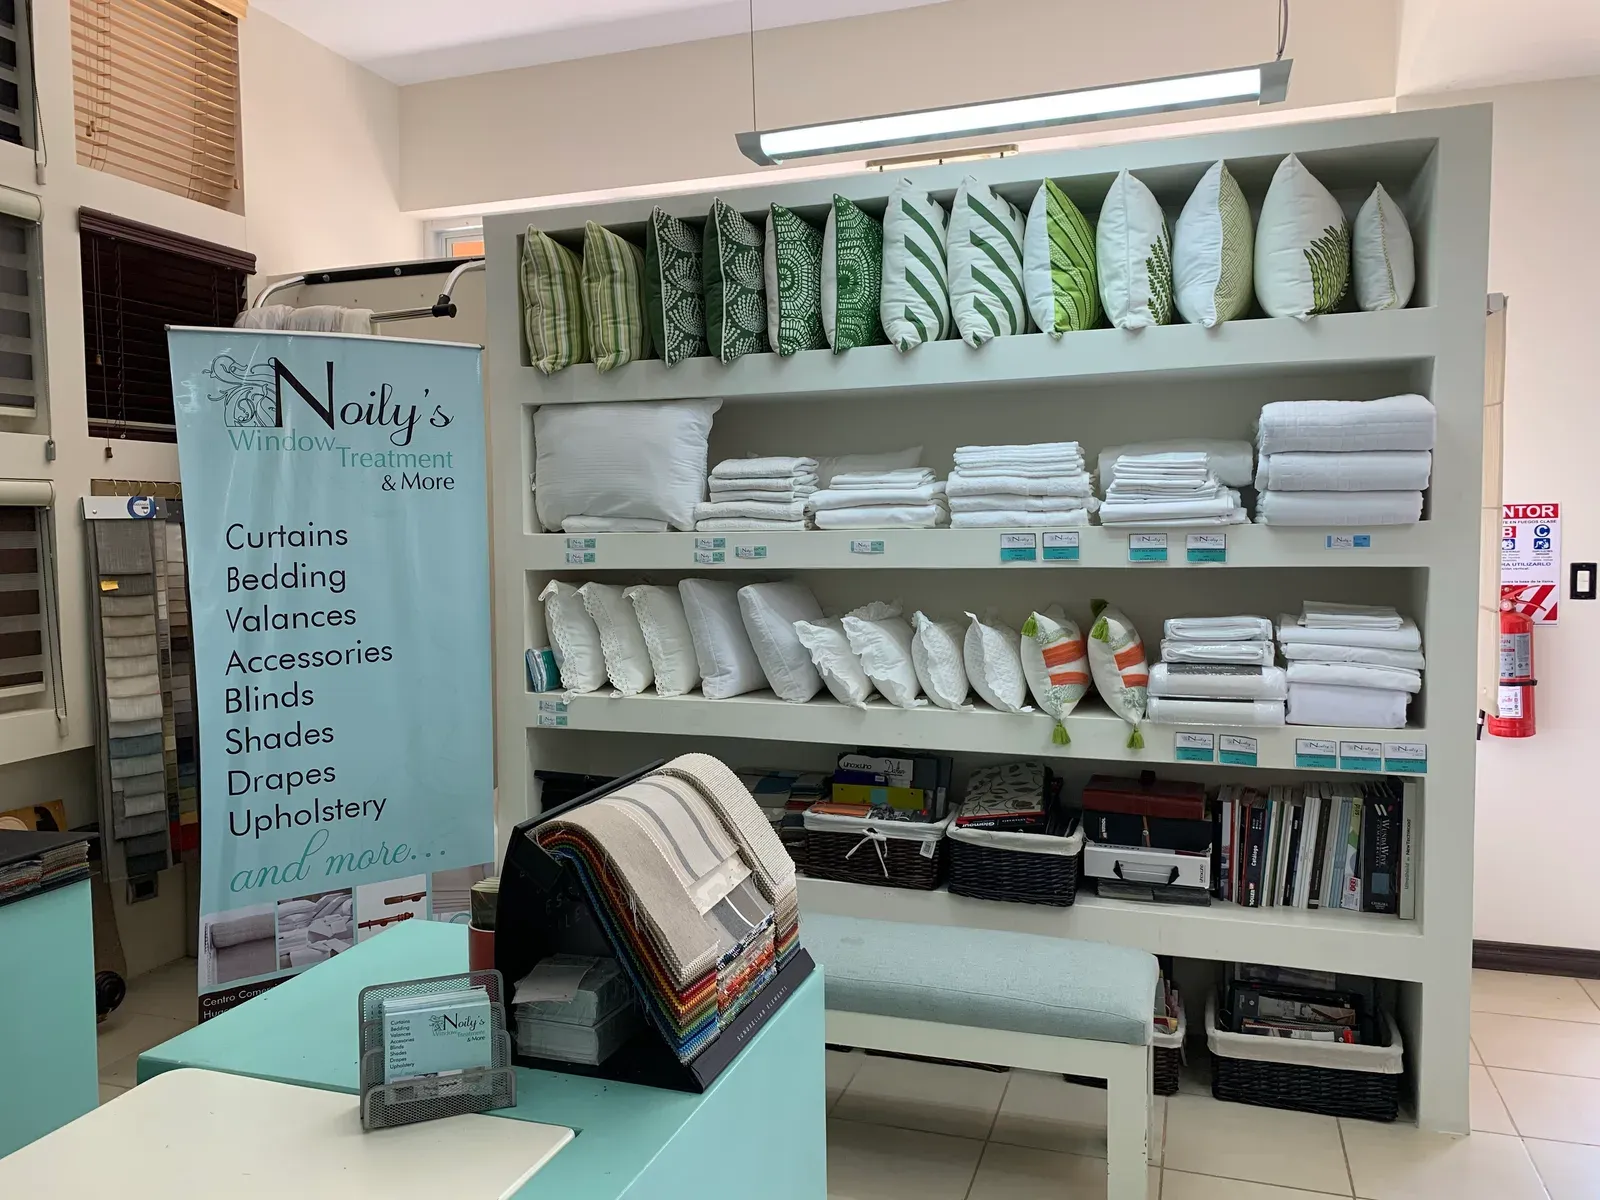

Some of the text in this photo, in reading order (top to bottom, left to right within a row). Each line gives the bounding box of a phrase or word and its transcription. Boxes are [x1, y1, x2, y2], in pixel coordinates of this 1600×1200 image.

[268, 357, 455, 446] Noily's
[228, 428, 454, 469] Window Treatment
[381, 472, 455, 491] & More
[225, 522, 348, 550] Curtains
[1503, 526, 1548, 538] B C
[227, 561, 346, 593] Bedding
[225, 604, 357, 633] Valances
[225, 639, 393, 675] Accessories
[225, 681, 315, 714] Blinds
[225, 721, 334, 755] Shades
[227, 766, 336, 796] Drapes
[229, 798, 387, 839] Upholstery
[230, 828, 329, 892] and
[203, 995, 236, 1007] Centro
[443, 1013, 485, 1031] Noily's
